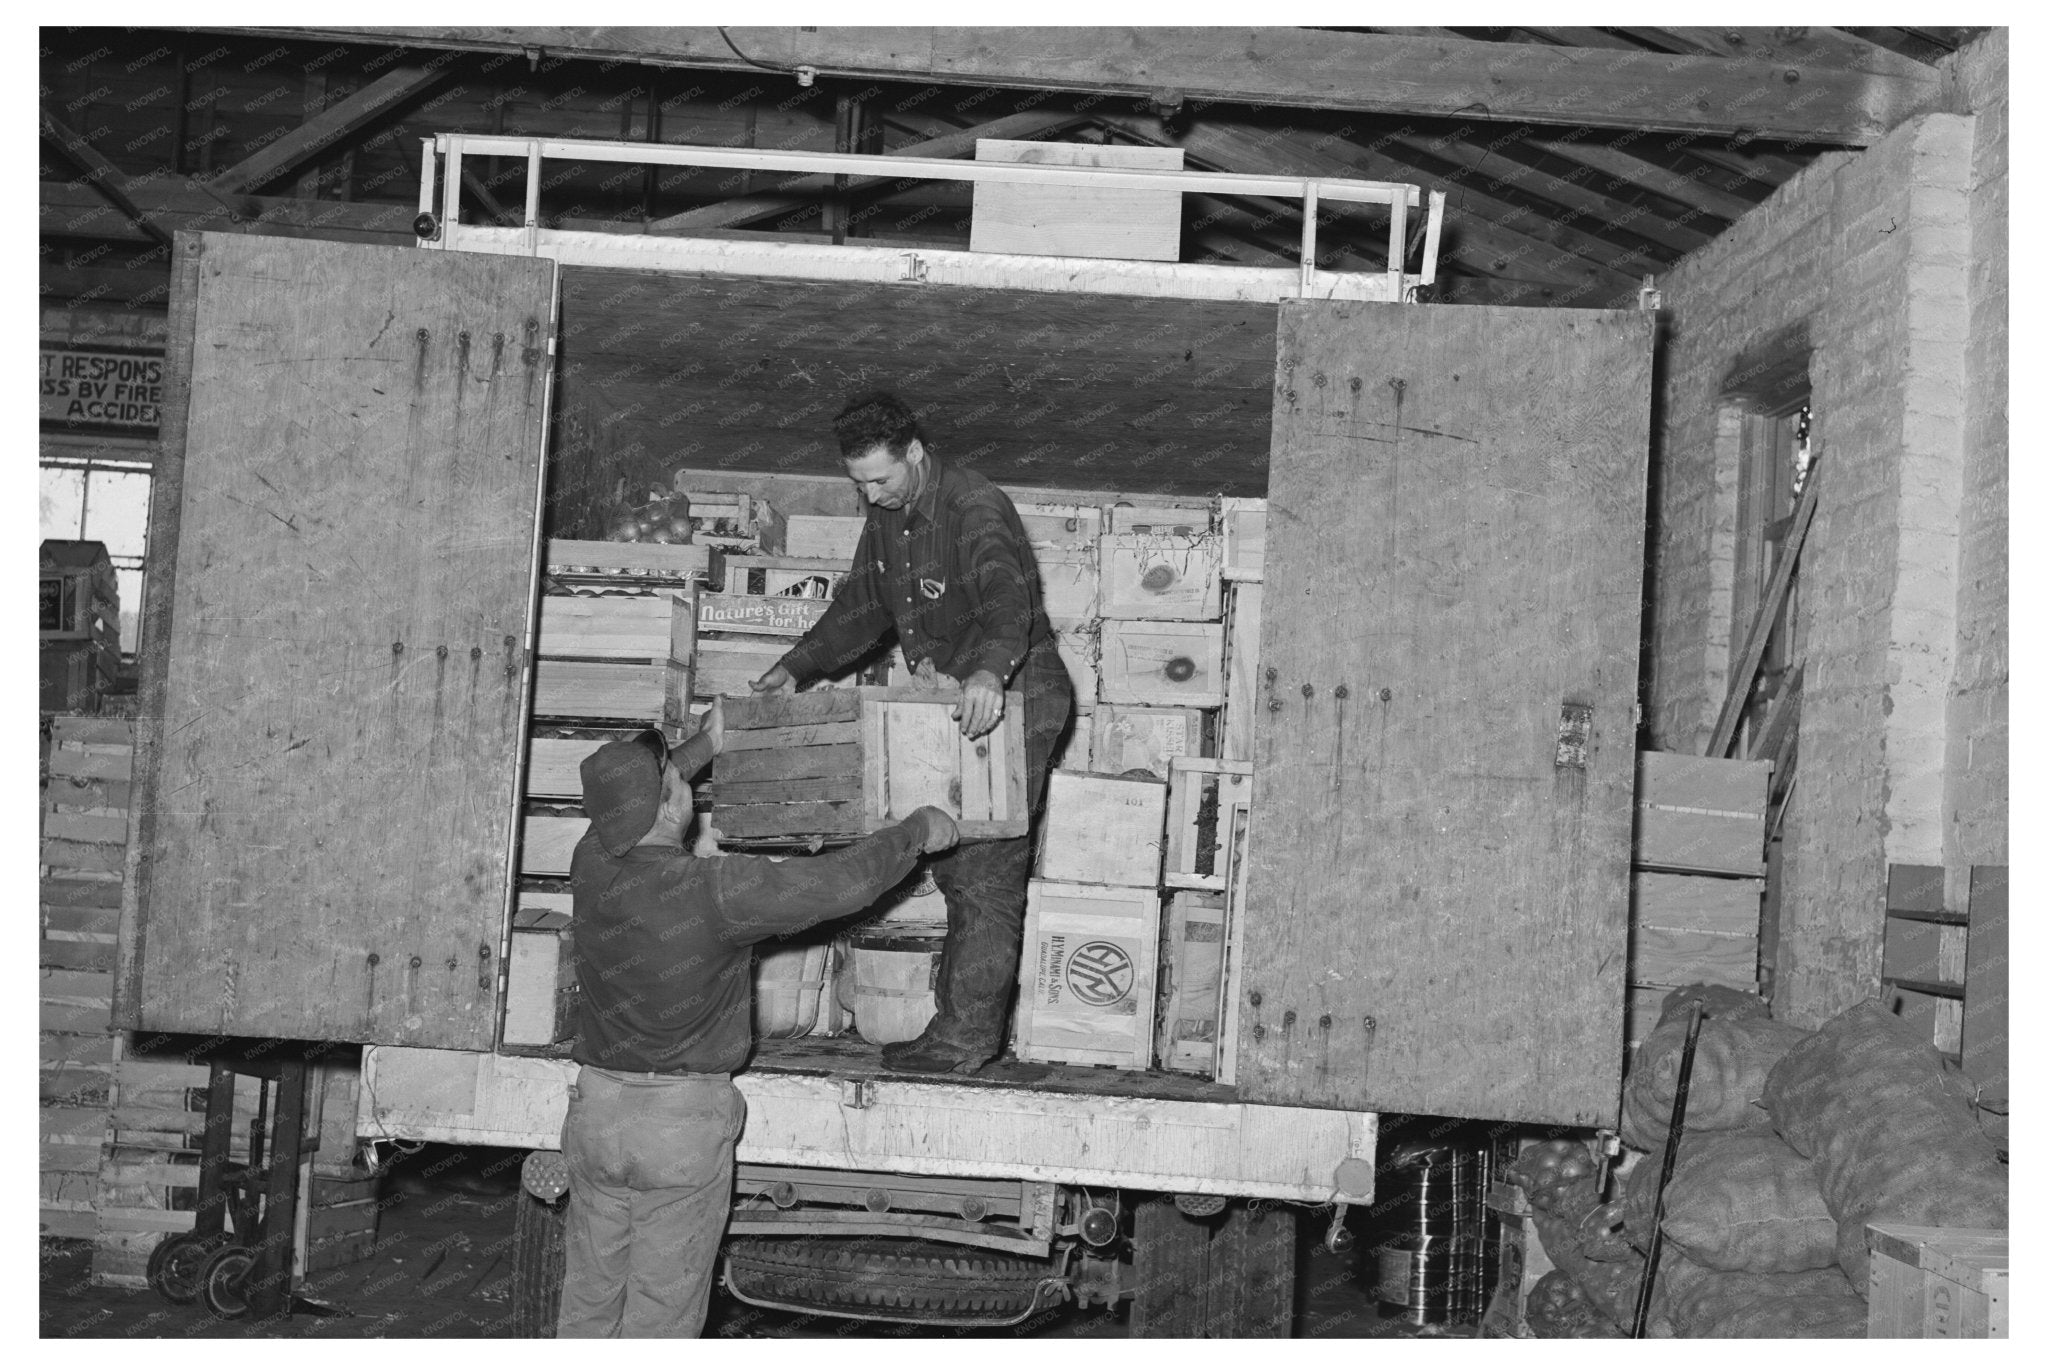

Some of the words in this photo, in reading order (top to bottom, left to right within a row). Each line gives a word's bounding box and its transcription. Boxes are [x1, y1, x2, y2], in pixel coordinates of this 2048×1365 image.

[115, 383, 162, 403] FIRE
[778, 603, 810, 616] Gift
[768, 614, 793, 628] for
